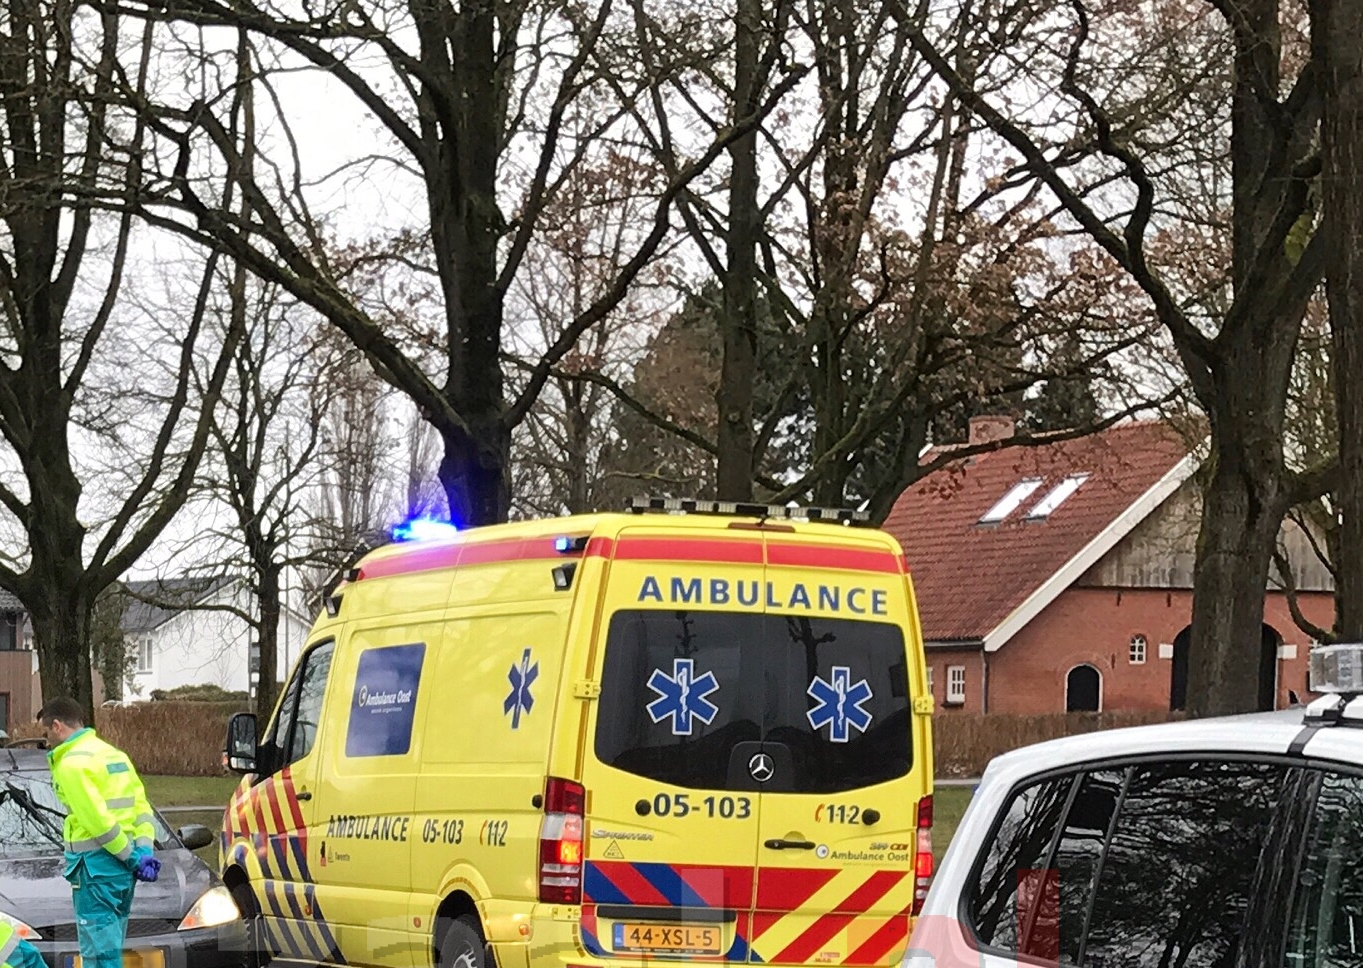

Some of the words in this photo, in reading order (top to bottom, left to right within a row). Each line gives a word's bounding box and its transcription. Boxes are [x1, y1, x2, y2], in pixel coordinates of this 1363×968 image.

[637, 576, 888, 615] AMBULANCE
[366, 691, 397, 706] Ambulance
[653, 793, 751, 819] 05-103
[326, 815, 410, 842] AMBULANCE
[422, 819, 465, 845] 05-103
[830, 850, 885, 861] Ambulance
[887, 852, 909, 862] Oost
[630, 926, 713, 947] 44-XSL-5
